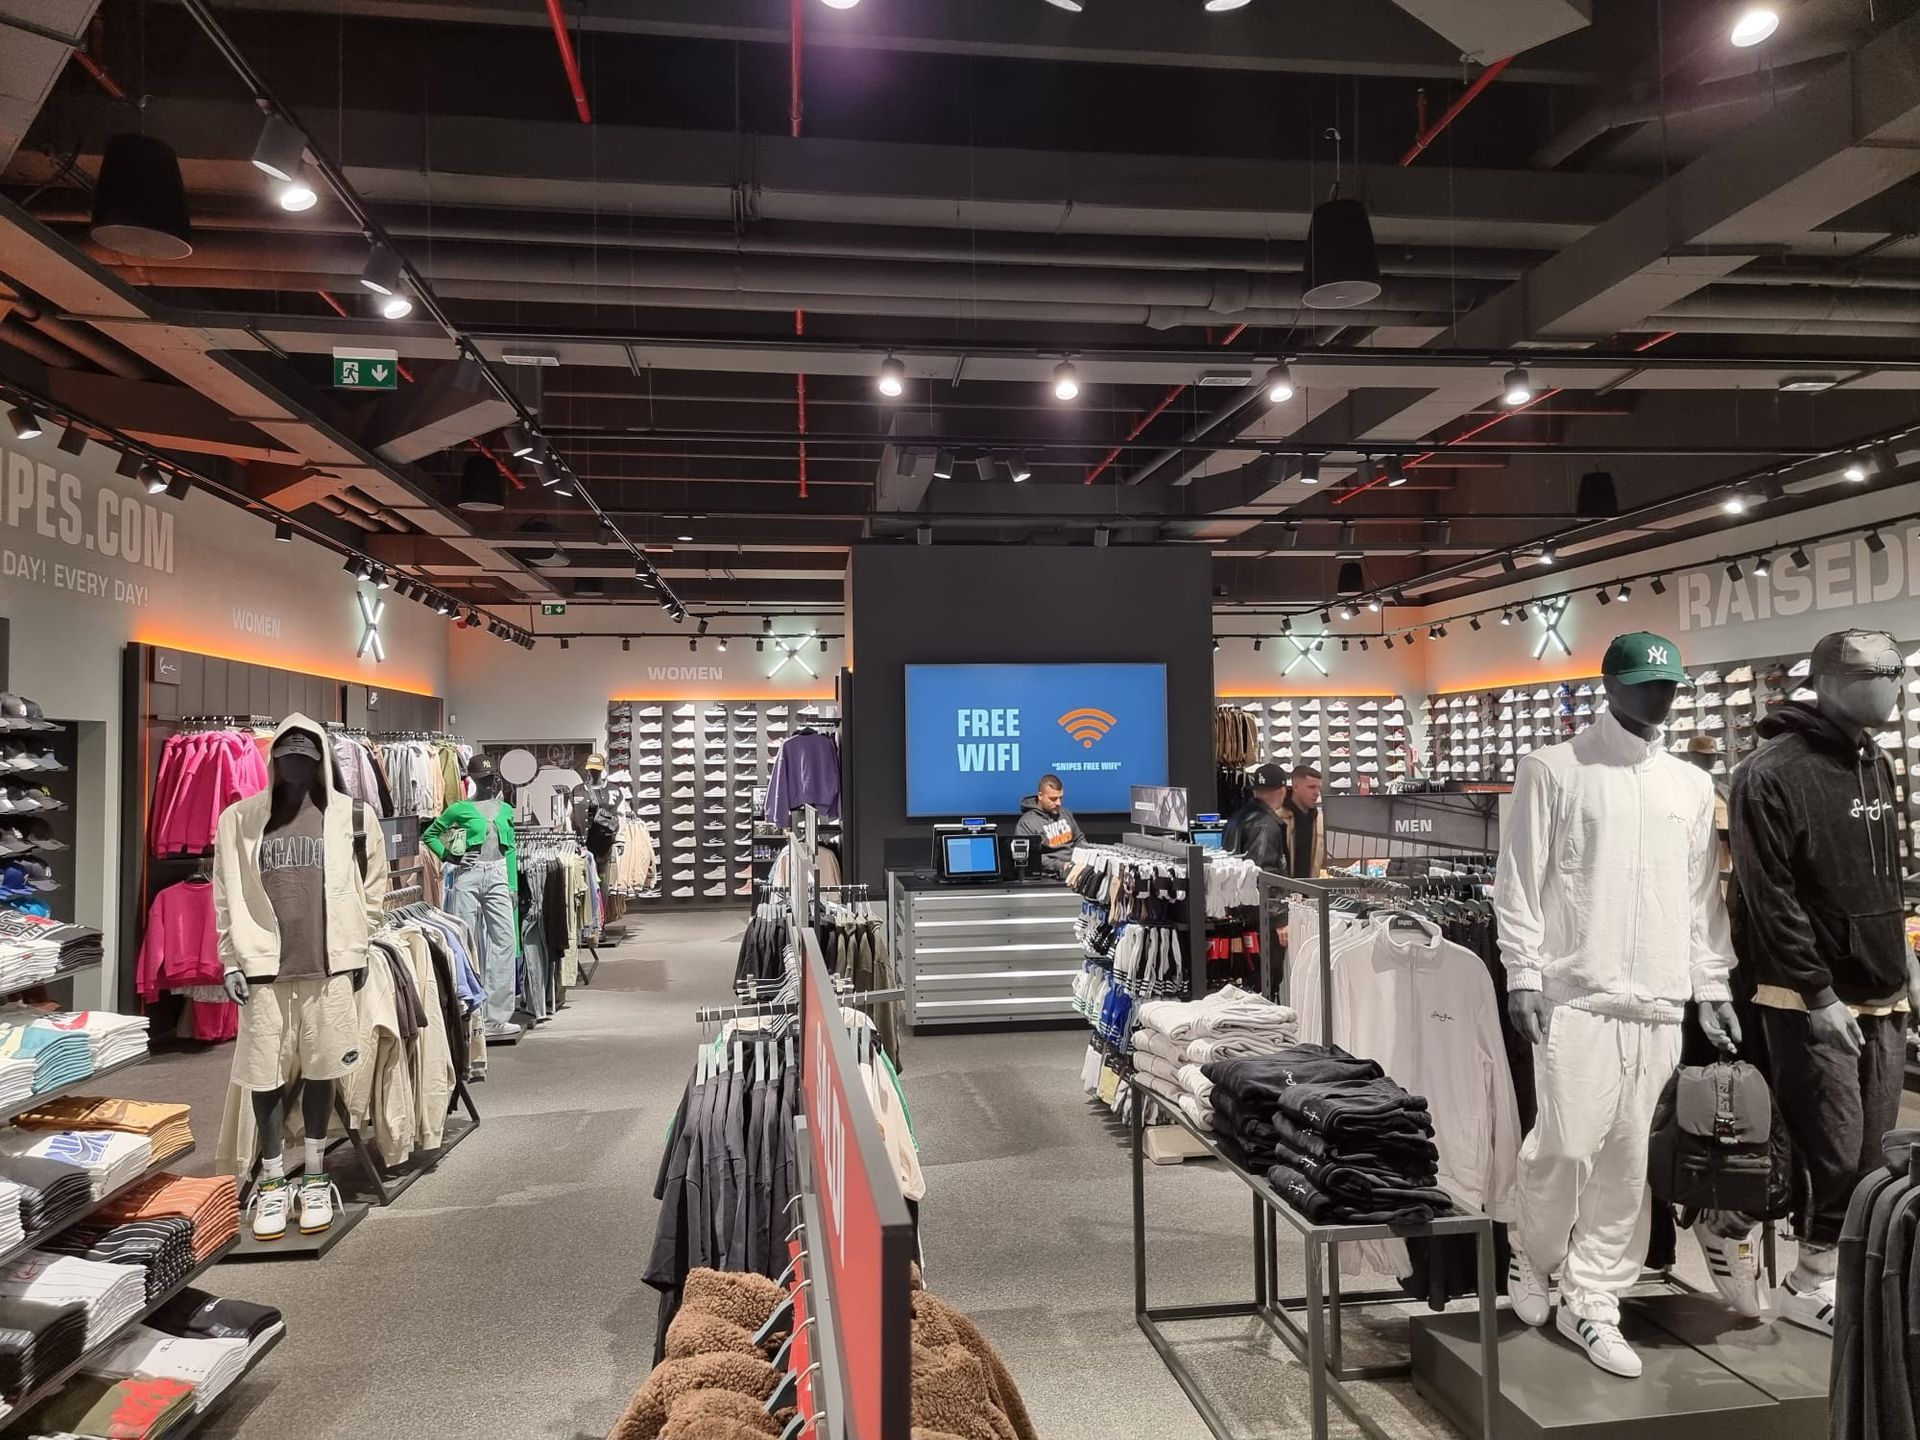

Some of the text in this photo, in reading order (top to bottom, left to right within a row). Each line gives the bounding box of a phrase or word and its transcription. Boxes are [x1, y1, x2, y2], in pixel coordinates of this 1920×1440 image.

[0, 447, 174, 574] PES.COM
[3, 550, 149, 607] DAY! EVERY DAY!
[232, 607, 280, 639] WOMEN
[647, 666, 723, 681] WOMEN
[957, 708, 1020, 737] FREE
[957, 743, 1020, 772] WIFI
[1083, 762, 1100, 771] FREE
[1394, 819, 1433, 833] MEN
